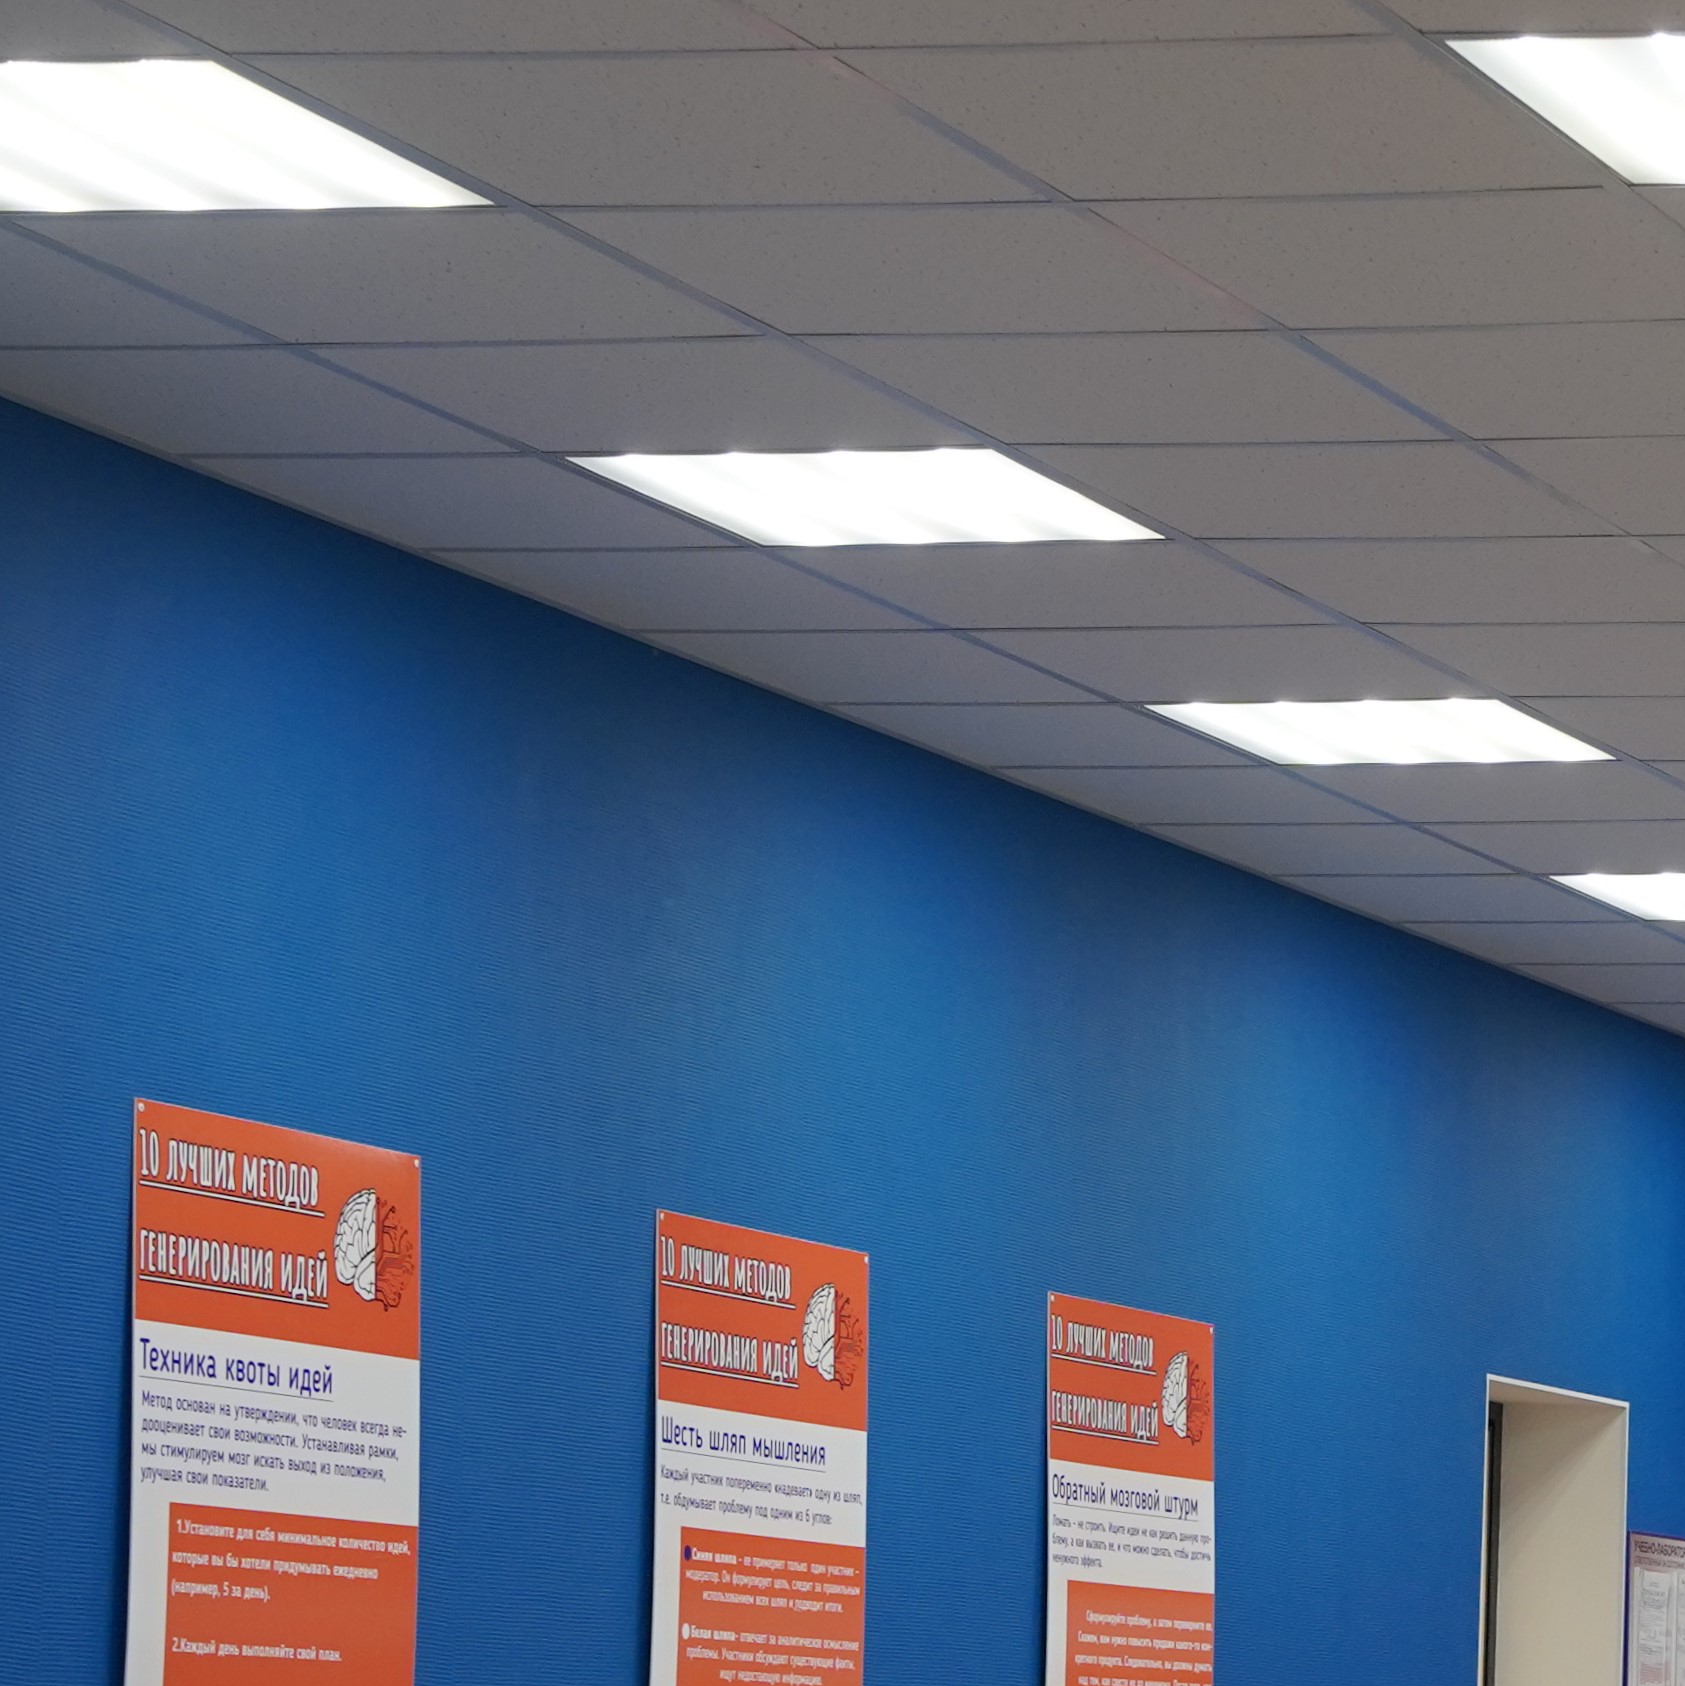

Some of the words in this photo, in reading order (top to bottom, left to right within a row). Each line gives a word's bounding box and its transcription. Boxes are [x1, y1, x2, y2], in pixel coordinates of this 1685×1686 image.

[138, 1128, 159, 1176] 10
[165, 1139, 236, 1190] ЛУЧШИХ
[241, 1154, 318, 1209] МЕТОДОВ
[139, 1228, 273, 1289] ГЕНЕРИРОВАНИЯ
[279, 1251, 328, 1300] ИДЕЙ
[659, 1235, 675, 1276] 10
[679, 1244, 730, 1287] ЛУЧШИХ
[733, 1256, 791, 1300] МЕТОДОВ
[660, 1321, 758, 1372] ГЕНЕРИРОВАНИЯ
[761, 1338, 798, 1382] ИДЕЙ
[1048, 1314, 1063, 1350] 10
[1065, 1321, 1106, 1358] ЛУЧШИХ
[1107, 1330, 1154, 1369] МЕТОДОВ
[139, 1337, 217, 1378] Техника
[224, 1357, 280, 1387] квоты
[288, 1364, 333, 1397] идей
[140, 1389, 173, 1411] Метод
[174, 1397, 216, 1414] основан
[218, 1403, 231, 1417] на
[301, 1413, 318, 1427] что
[319, 1416, 357, 1432] человек
[359, 1420, 390, 1437] всегда
[391, 1425, 407, 1438] не-
[140, 1417, 206, 1437] дооценивает
[207, 1425, 231, 1439] свои
[301, 1433, 365, 1455] Устанавливая
[1050, 1390, 1127, 1432] ГЕНЕРИРОВАНИЯ
[1129, 1401, 1159, 1440] ИДЕЙ
[140, 1442, 157, 1455] мы
[159, 1443, 225, 1465] стимулируем
[227, 1452, 251, 1465] мозг
[252, 1454, 285, 1470] искать
[287, 1458, 317, 1475] выход
[319, 1462, 331, 1475] из
[660, 1415, 703, 1448] Шесть
[708, 1430, 746, 1454] шляп
[751, 1436, 826, 1465] мышления
[139, 1466, 183, 1483] улучшая
[185, 1470, 209, 1484] свои
[1051, 1472, 1106, 1504] Обратный
[1109, 1488, 1160, 1511] мозговой
[1163, 1495, 1198, 1519] штурм
[175, 1518, 235, 1538] 1.Установите
[234, 1527, 254, 1541] для
[254, 1526, 276, 1541] себя
[275, 1531, 337, 1547] минимальное
[337, 1537, 387, 1552] количество
